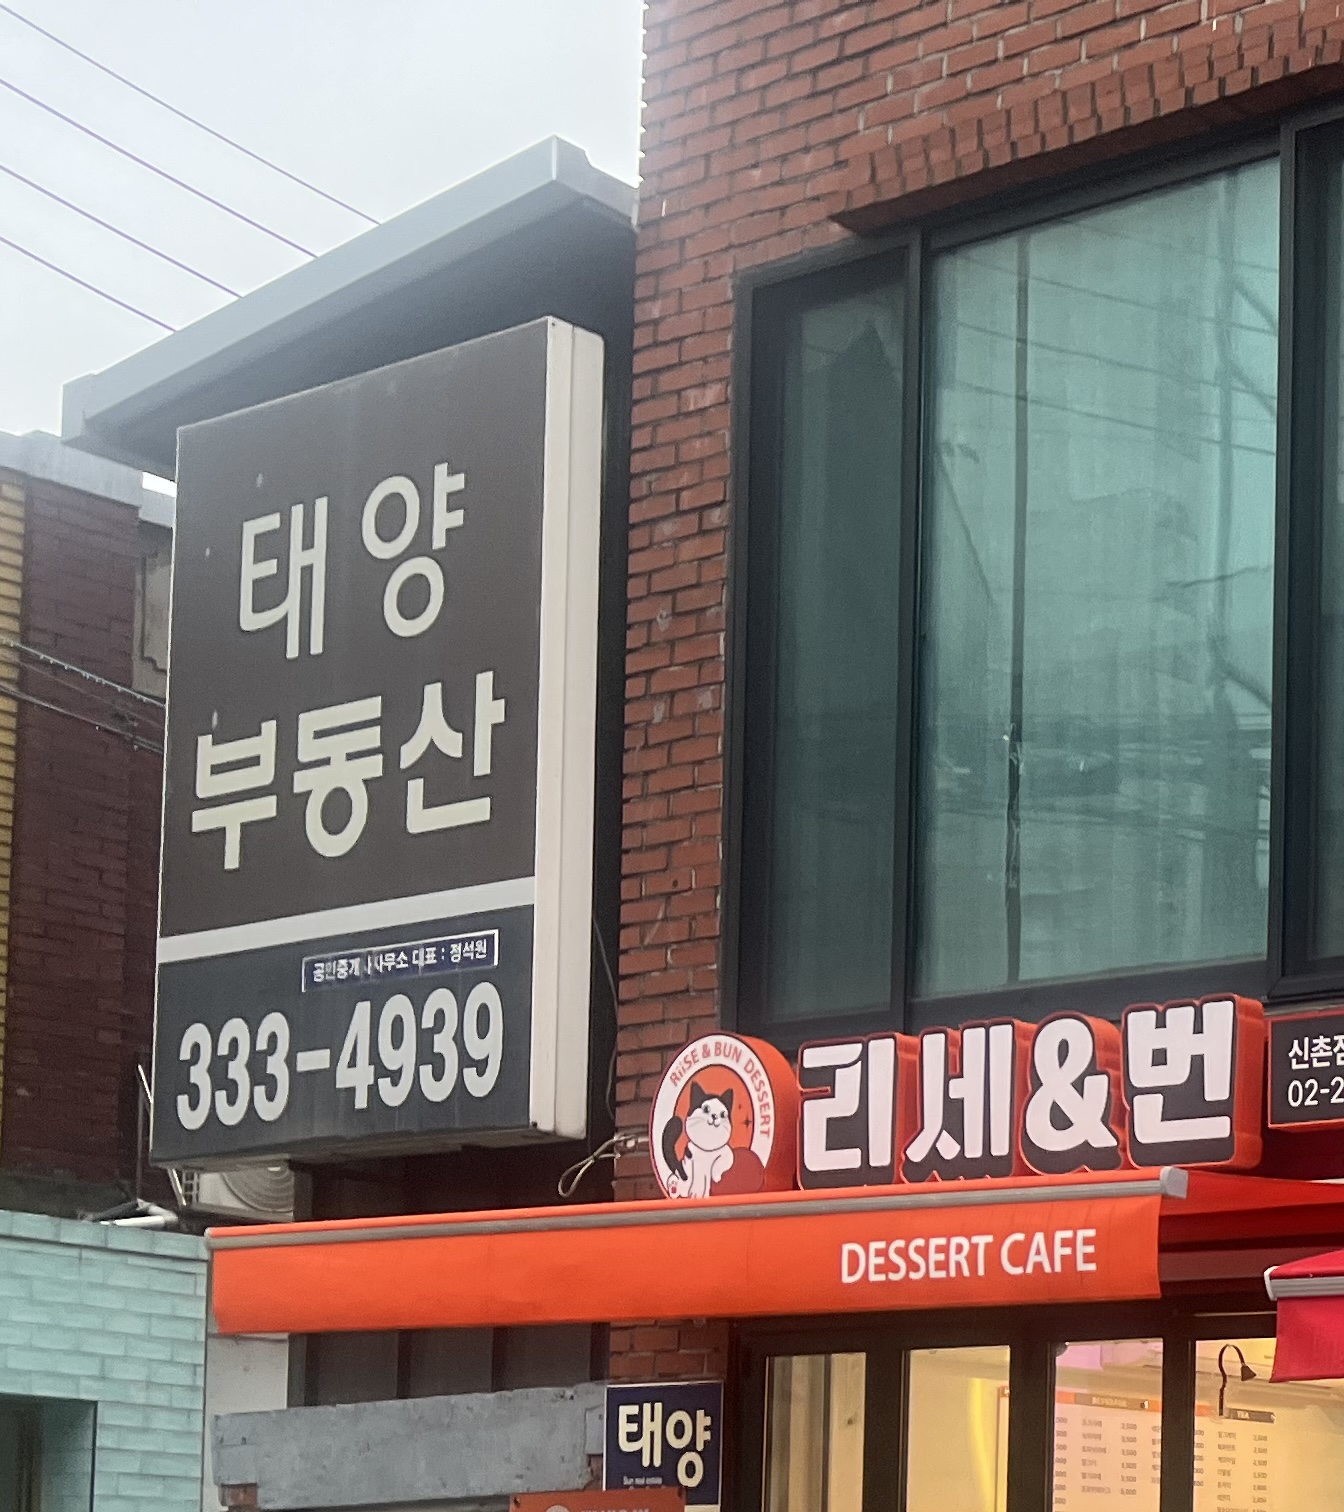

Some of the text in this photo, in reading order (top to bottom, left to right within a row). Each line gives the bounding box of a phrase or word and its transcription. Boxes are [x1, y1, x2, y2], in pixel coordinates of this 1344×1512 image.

[237, 461, 467, 660] 태양
[191, 670, 506, 870] 부동산
[175, 980, 505, 1132] 333-4939
[714, 1041, 743, 1063] BUN
[743, 1058, 771, 1140] DESSERT
[800, 1000, 1236, 1173] 리세&번
[840, 1228, 1098, 1284] DESSERT CAFE
[617, 1401, 712, 1488] 태양
